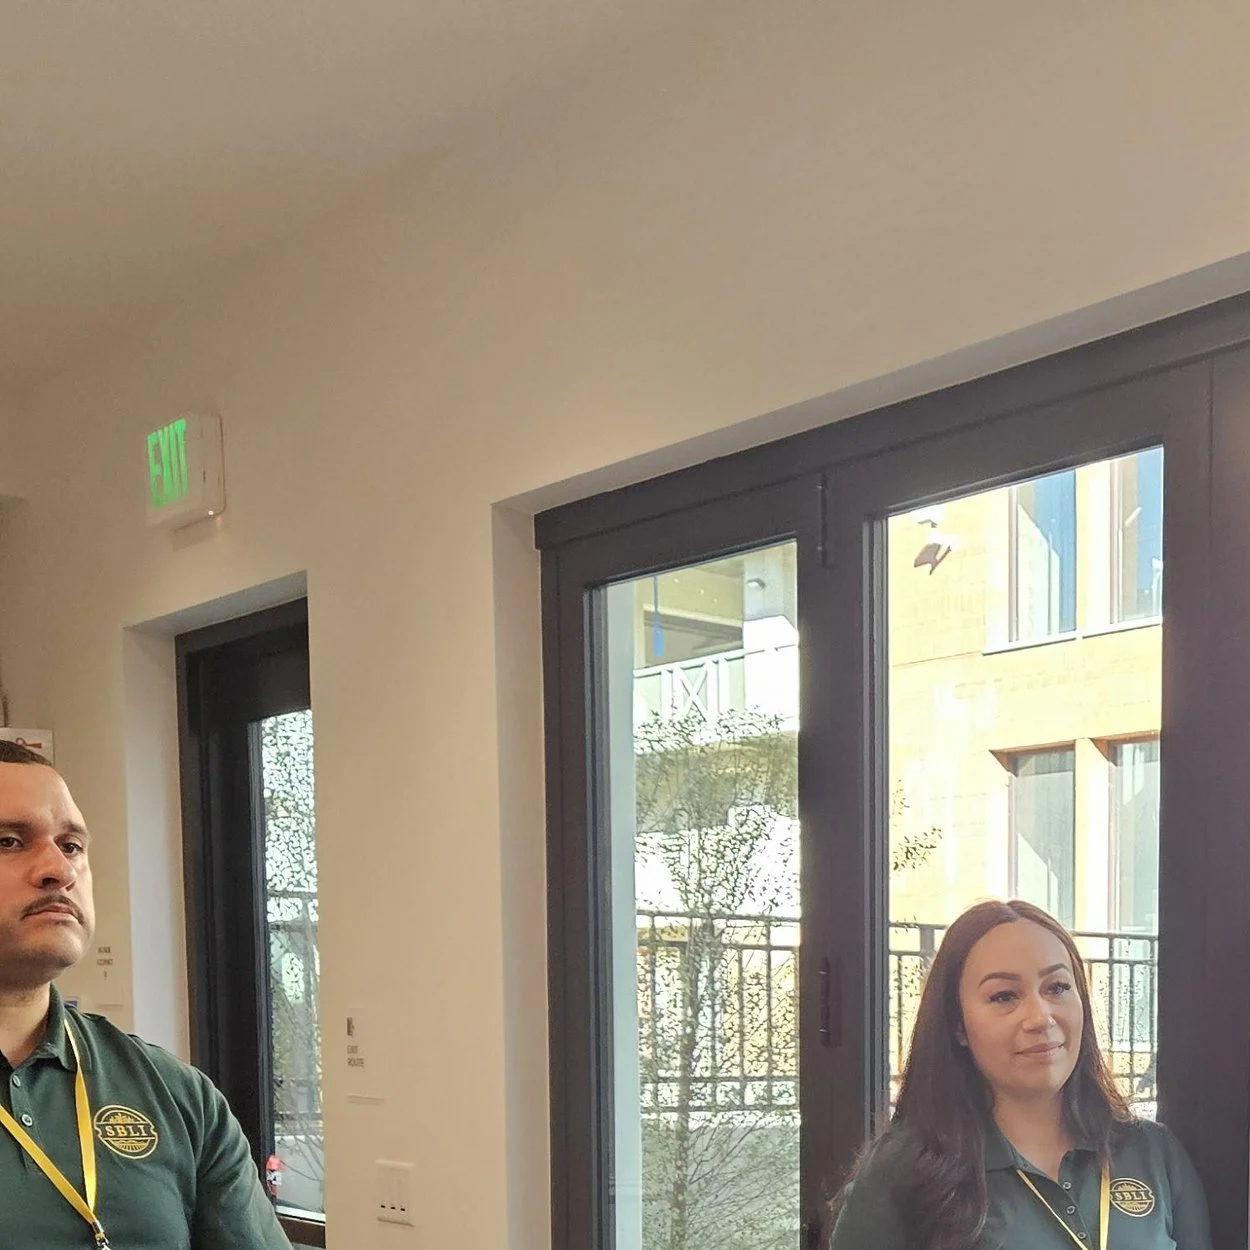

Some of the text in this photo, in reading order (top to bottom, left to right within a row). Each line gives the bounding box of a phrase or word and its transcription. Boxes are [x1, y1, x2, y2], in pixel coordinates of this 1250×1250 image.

[147, 419, 187, 507] EXIT
[105, 1125, 148, 1137] SBLI
[1115, 1191, 1148, 1201] SBLI
